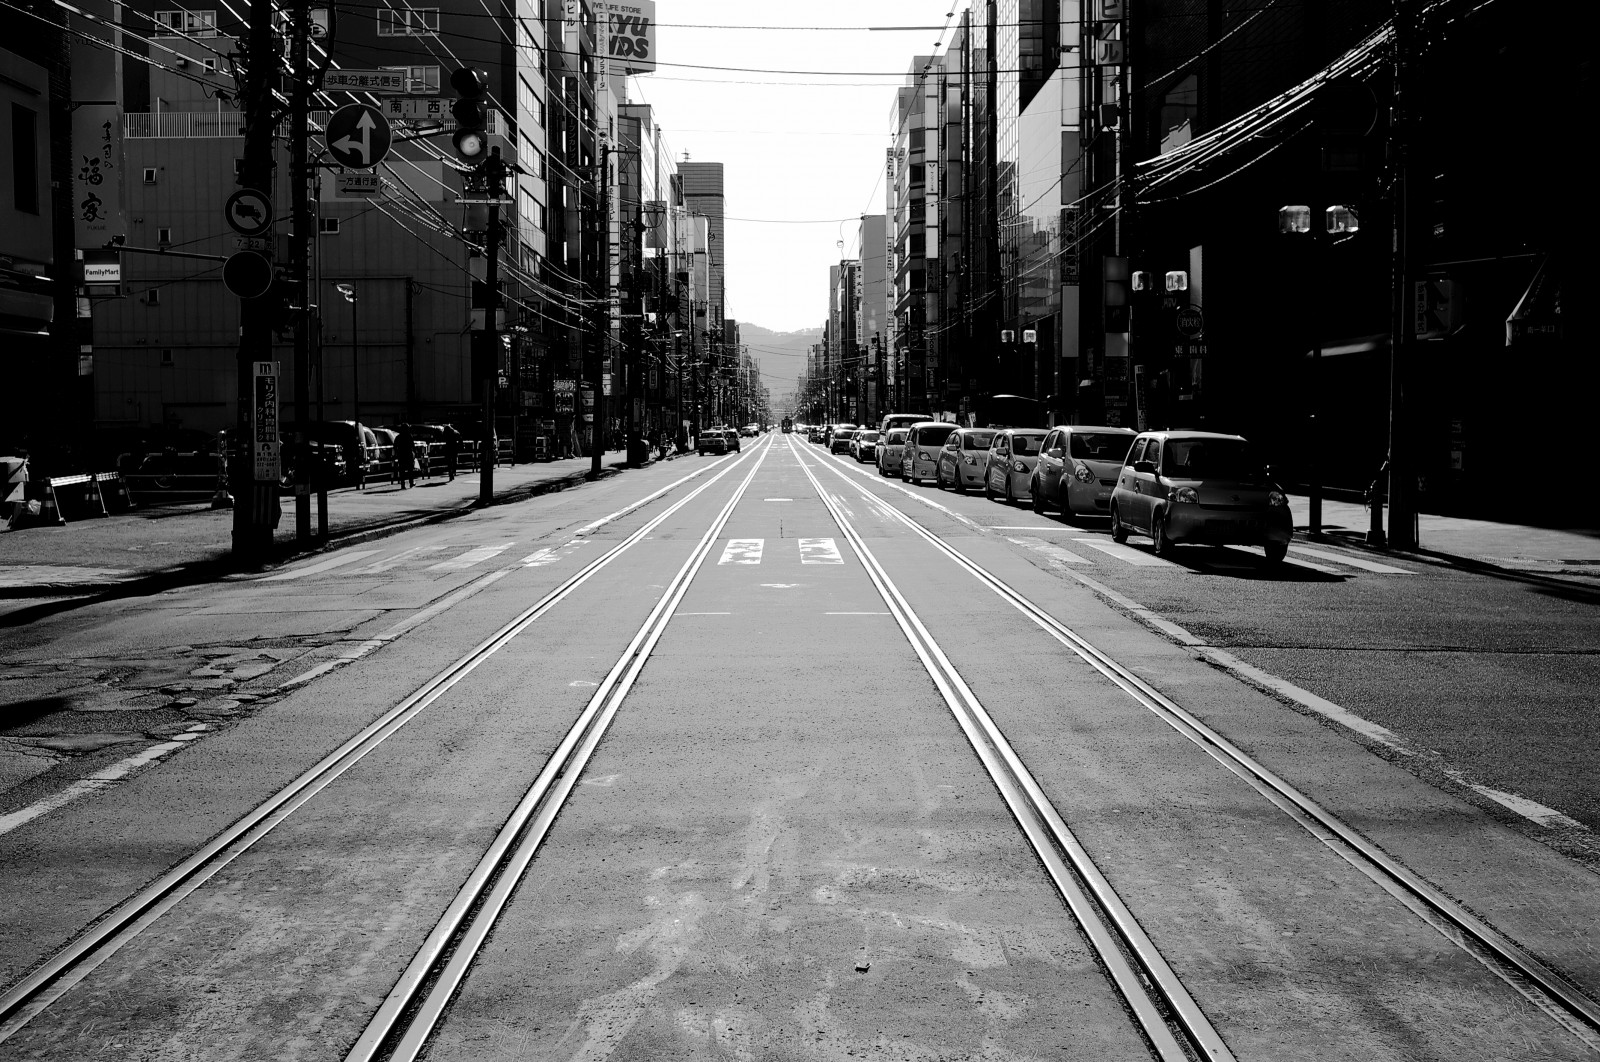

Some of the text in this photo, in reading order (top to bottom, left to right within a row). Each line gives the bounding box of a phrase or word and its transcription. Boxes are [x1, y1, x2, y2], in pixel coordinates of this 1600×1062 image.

[566, 0, 576, 26] ビル
[621, 5, 642, 14] STORE
[327, 75, 401, 88] 歩車分離式信号
[338, 177, 378, 186] 一方通行路
[78, 155, 106, 223] 福家
[236, 239, 260, 249] 7-22
[85, 269, 119, 277] FamilyMart
[1179, 316, 1201, 328] 消火栓
